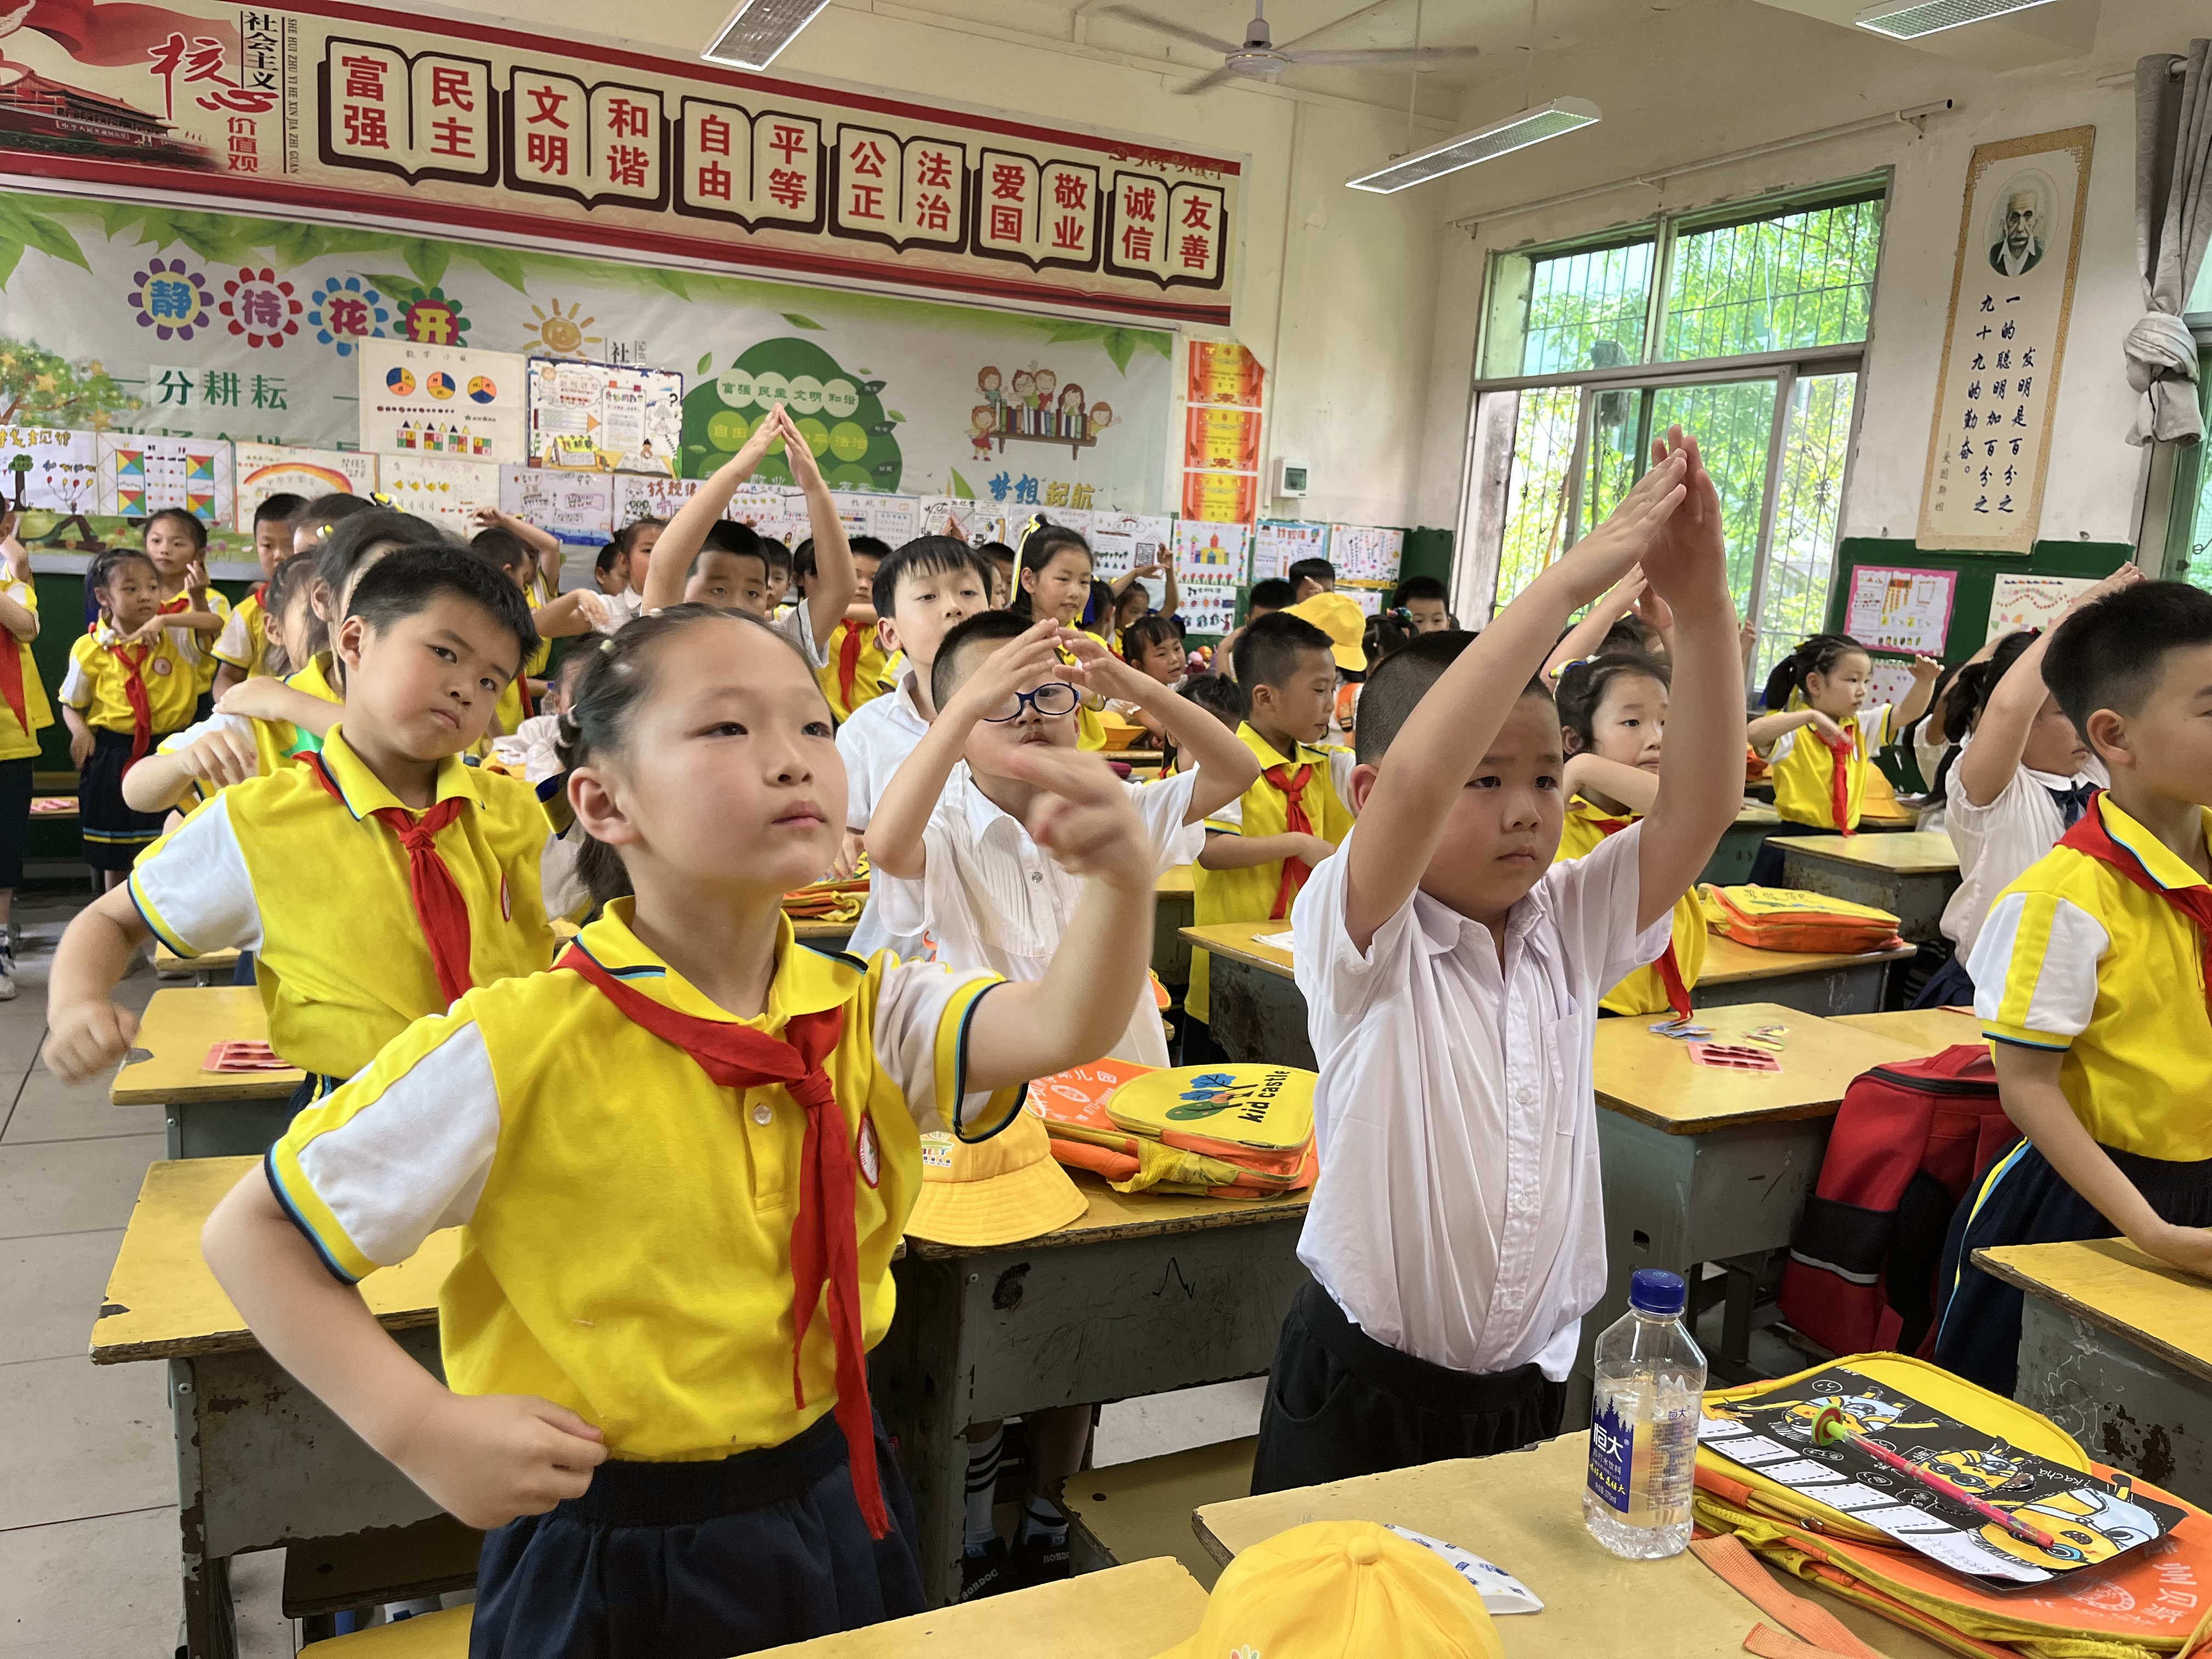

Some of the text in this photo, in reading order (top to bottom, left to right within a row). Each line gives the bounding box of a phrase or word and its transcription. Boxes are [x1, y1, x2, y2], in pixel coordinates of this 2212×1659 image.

[149, 34, 279, 120] 核心
[244, 12, 278, 89] 社会主义
[286, 18, 298, 174] SHE HUI ZHU YI HE XIN JIA ZHI GUAN
[342, 55, 390, 149] 富强
[431, 66, 476, 159] 民主
[527, 86, 569, 176] 文明
[228, 116, 257, 172] 价值观
[607, 98, 650, 188] 和谐
[698, 114, 731, 201] 自由
[769, 125, 808, 210] 平等
[848, 141, 887, 220] 公正
[916, 151, 951, 232] 法治
[990, 164, 1026, 243] 爱国
[1052, 173, 1087, 250] 敬业
[1121, 185, 1156, 262] 诚信
[1179, 195, 1212, 270] 友善
[150, 281, 452, 346] 静待花开
[722, 382, 856, 406] 富强 民主 文明 和谐
[1973, 296, 2021, 514] 一的聪明加百分之
[1998, 347, 2036, 513] 发明是百分之
[715, 425, 747, 438] 自由
[836, 436, 866, 450] 法治
[988, 471, 1095, 510] 梦想起航
[1238, 1102, 1270, 1122] kid
[1258, 1070, 1290, 1097] castle
[1593, 1422, 1623, 1463] 恒大
[1668, 1408, 1686, 1420] 恒大
[1593, 1448, 1621, 1475] 苏打水饮料
[961, 1568, 998, 1600] BOBDOG
